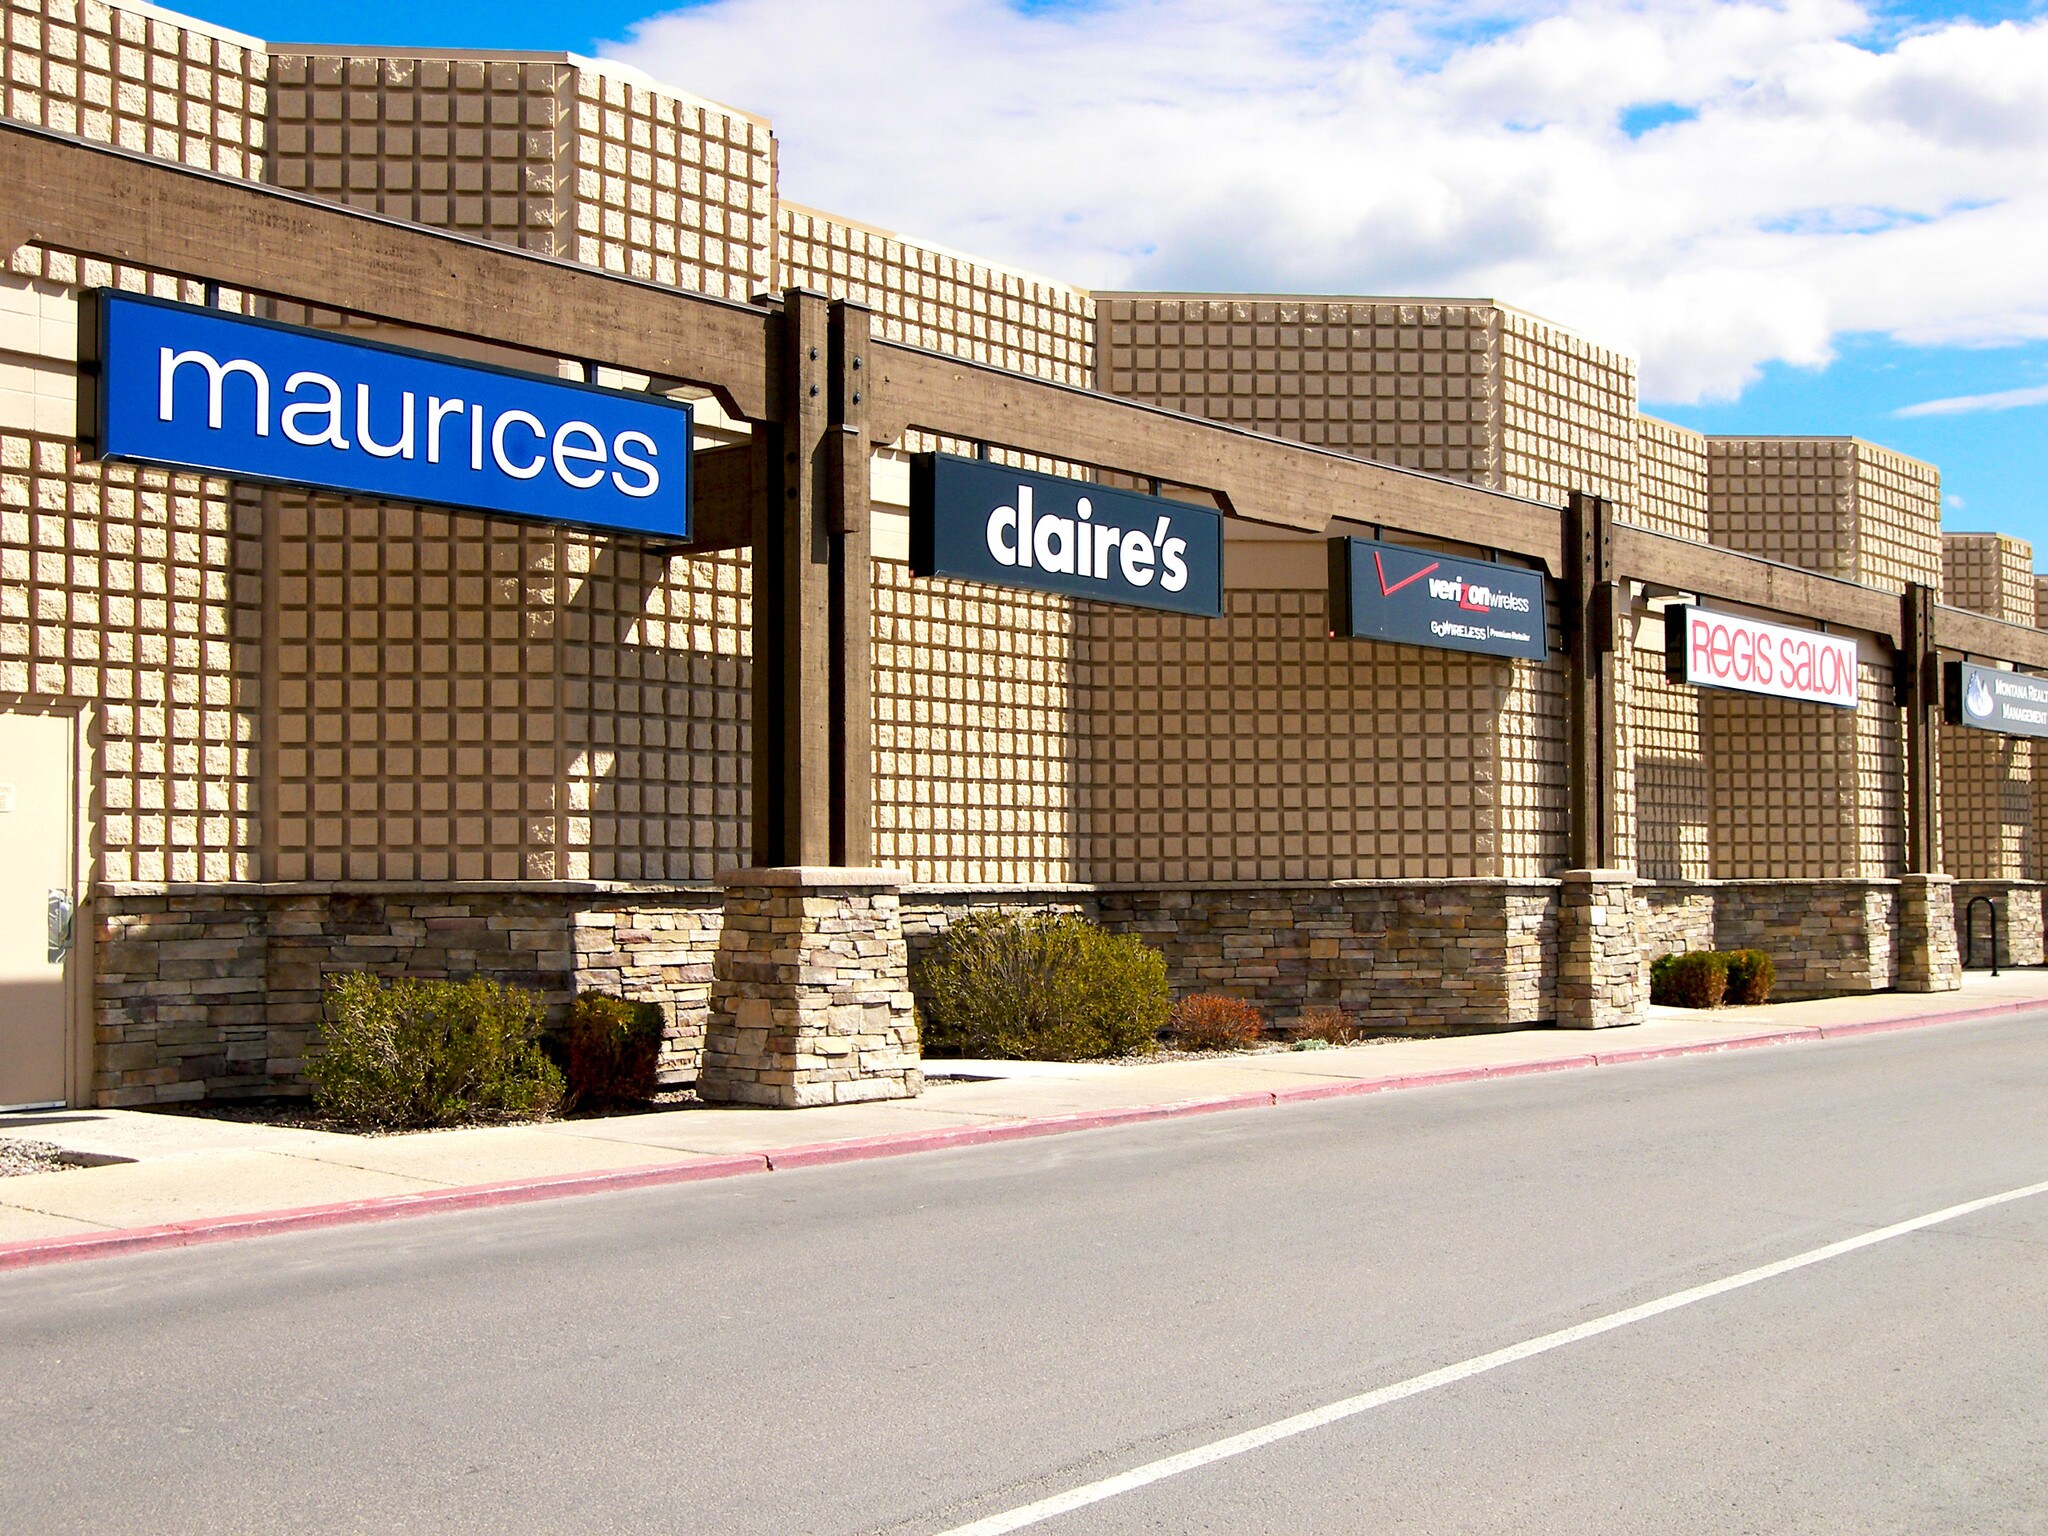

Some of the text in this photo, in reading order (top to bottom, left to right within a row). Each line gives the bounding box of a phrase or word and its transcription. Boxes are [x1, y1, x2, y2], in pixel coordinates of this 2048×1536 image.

[158, 345, 661, 498] maurices
[985, 484, 1189, 594] claire's
[1428, 575, 1530, 613] verizon wireless
